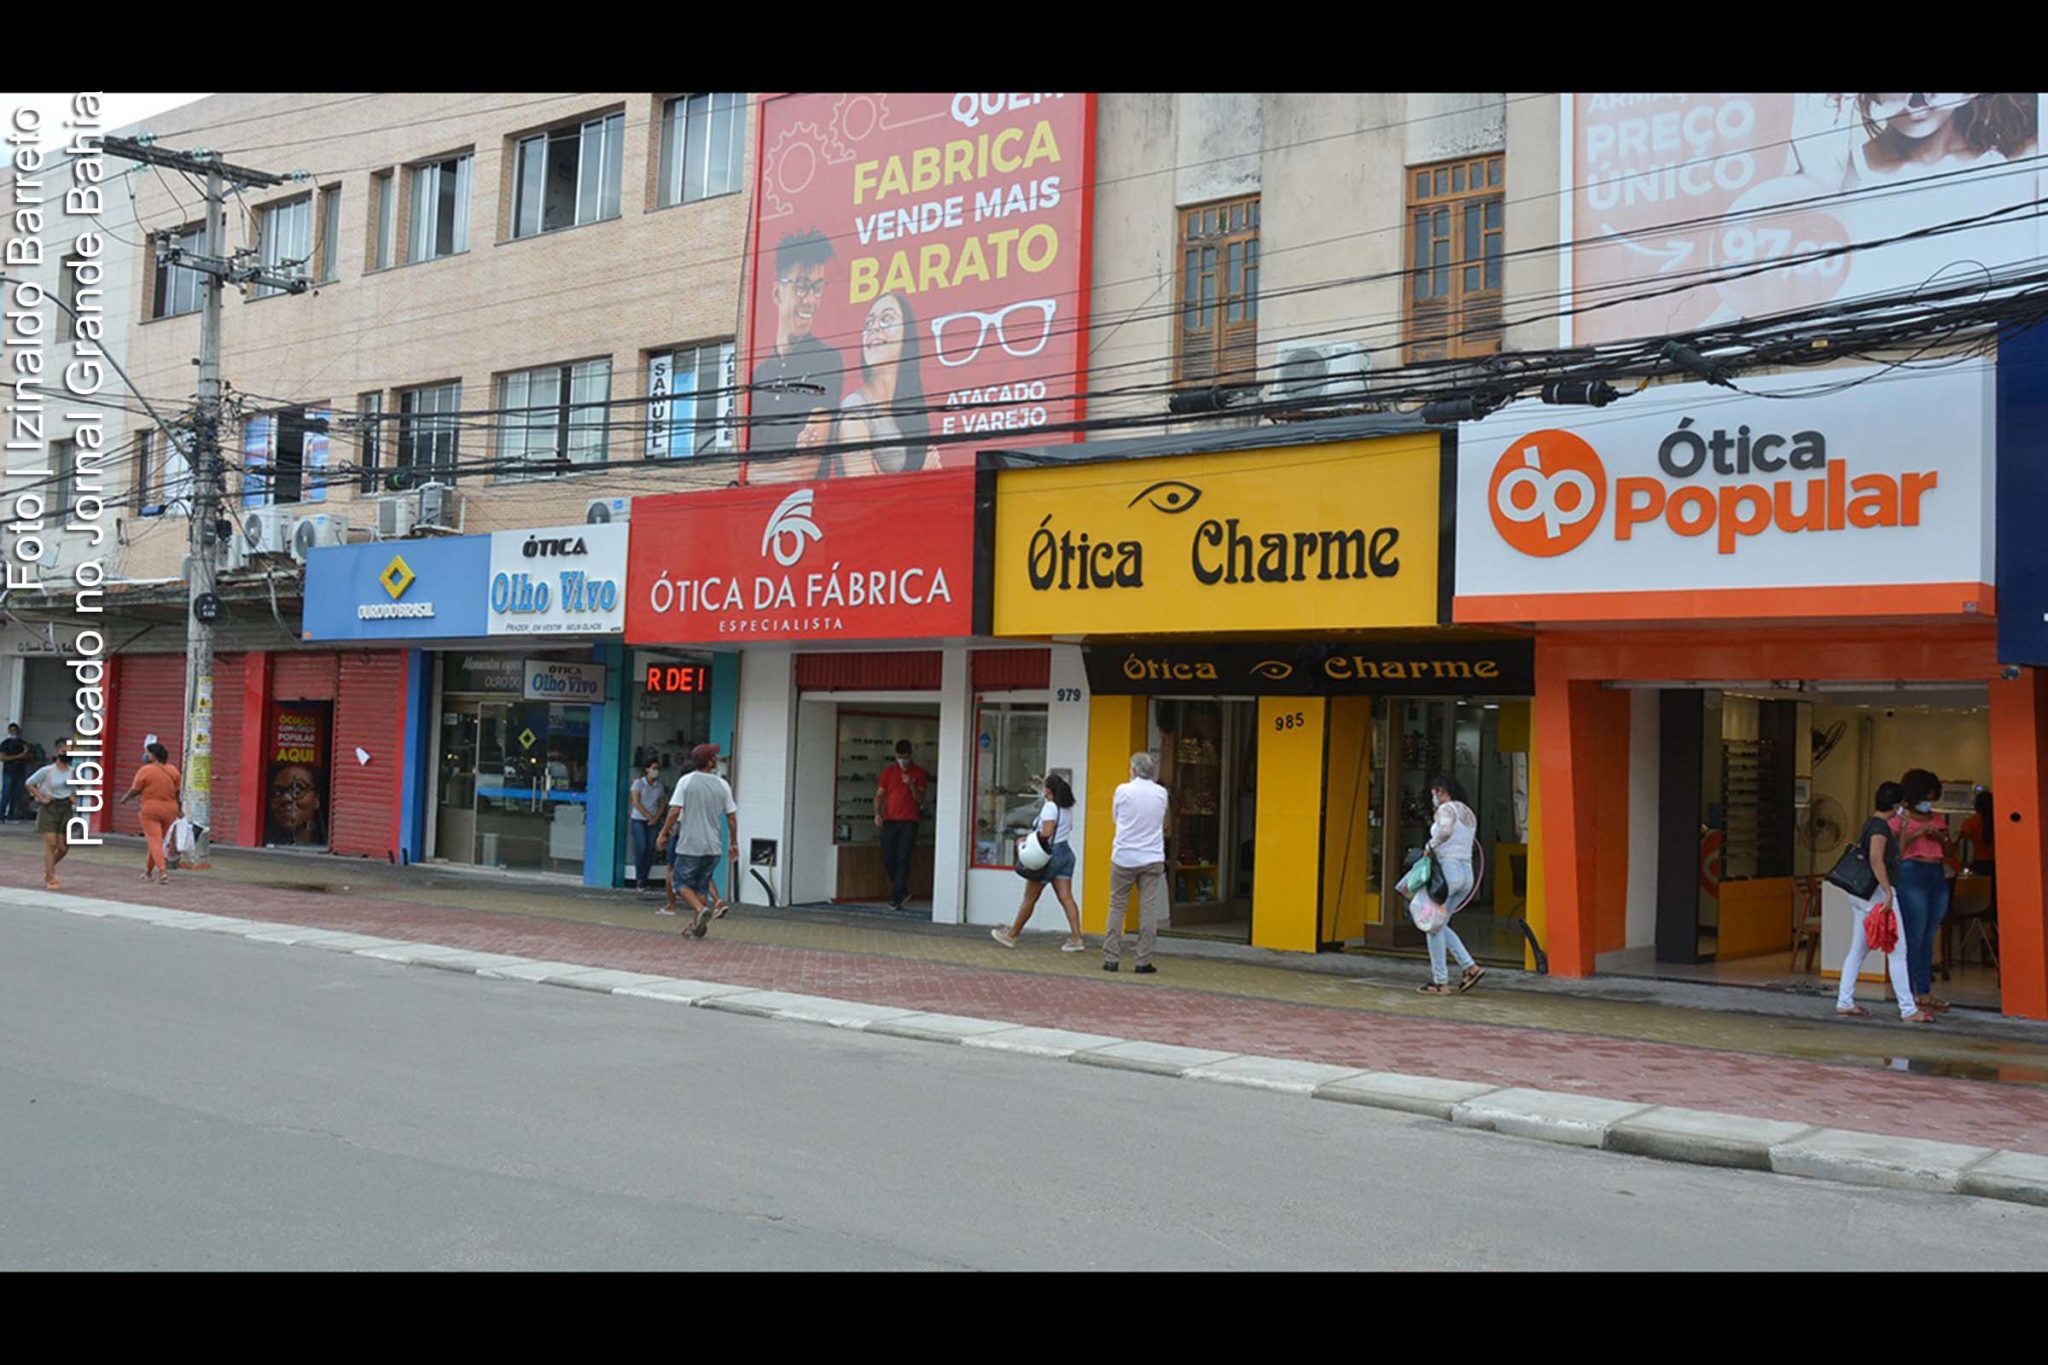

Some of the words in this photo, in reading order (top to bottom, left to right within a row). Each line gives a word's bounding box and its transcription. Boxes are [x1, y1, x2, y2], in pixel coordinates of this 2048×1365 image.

[1586, 101, 1756, 164] PREÇO
[853, 120, 1062, 205] FABRICA
[1586, 153, 1755, 210] ÚNICO
[855, 195, 964, 245] VENDE
[974, 176, 1061, 222] MAIS
[849, 223, 1059, 304] BARATO
[945, 380, 1047, 408] ATACADO
[942, 417, 956, 434] E
[961, 406, 1047, 433] VAREJO
[1657, 417, 1826, 478] Ótica
[1614, 459, 1938, 554] Popular
[523, 534, 588, 558] ÓTICA
[1028, 514, 1143, 591] Ótica
[1192, 518, 1400, 585] Charme
[491, 572, 551, 614] Olho
[560, 571, 618, 612] Vivo
[650, 571, 744, 613] ÓTICA
[754, 575, 797, 609] DA
[807, 562, 952, 607] FÁBRICA
[719, 617, 844, 632] ESPECIALISTA
[532, 673, 566, 691] Olho
[569, 679, 598, 694] Vivo
[666, 668, 693, 691] DE
[1123, 652, 1219, 681] Ótica
[1324, 656, 1500, 680] Charme
[1057, 688, 1081, 701] 979
[1275, 712, 1304, 730] 985
[276, 748, 315, 762] AQUI
